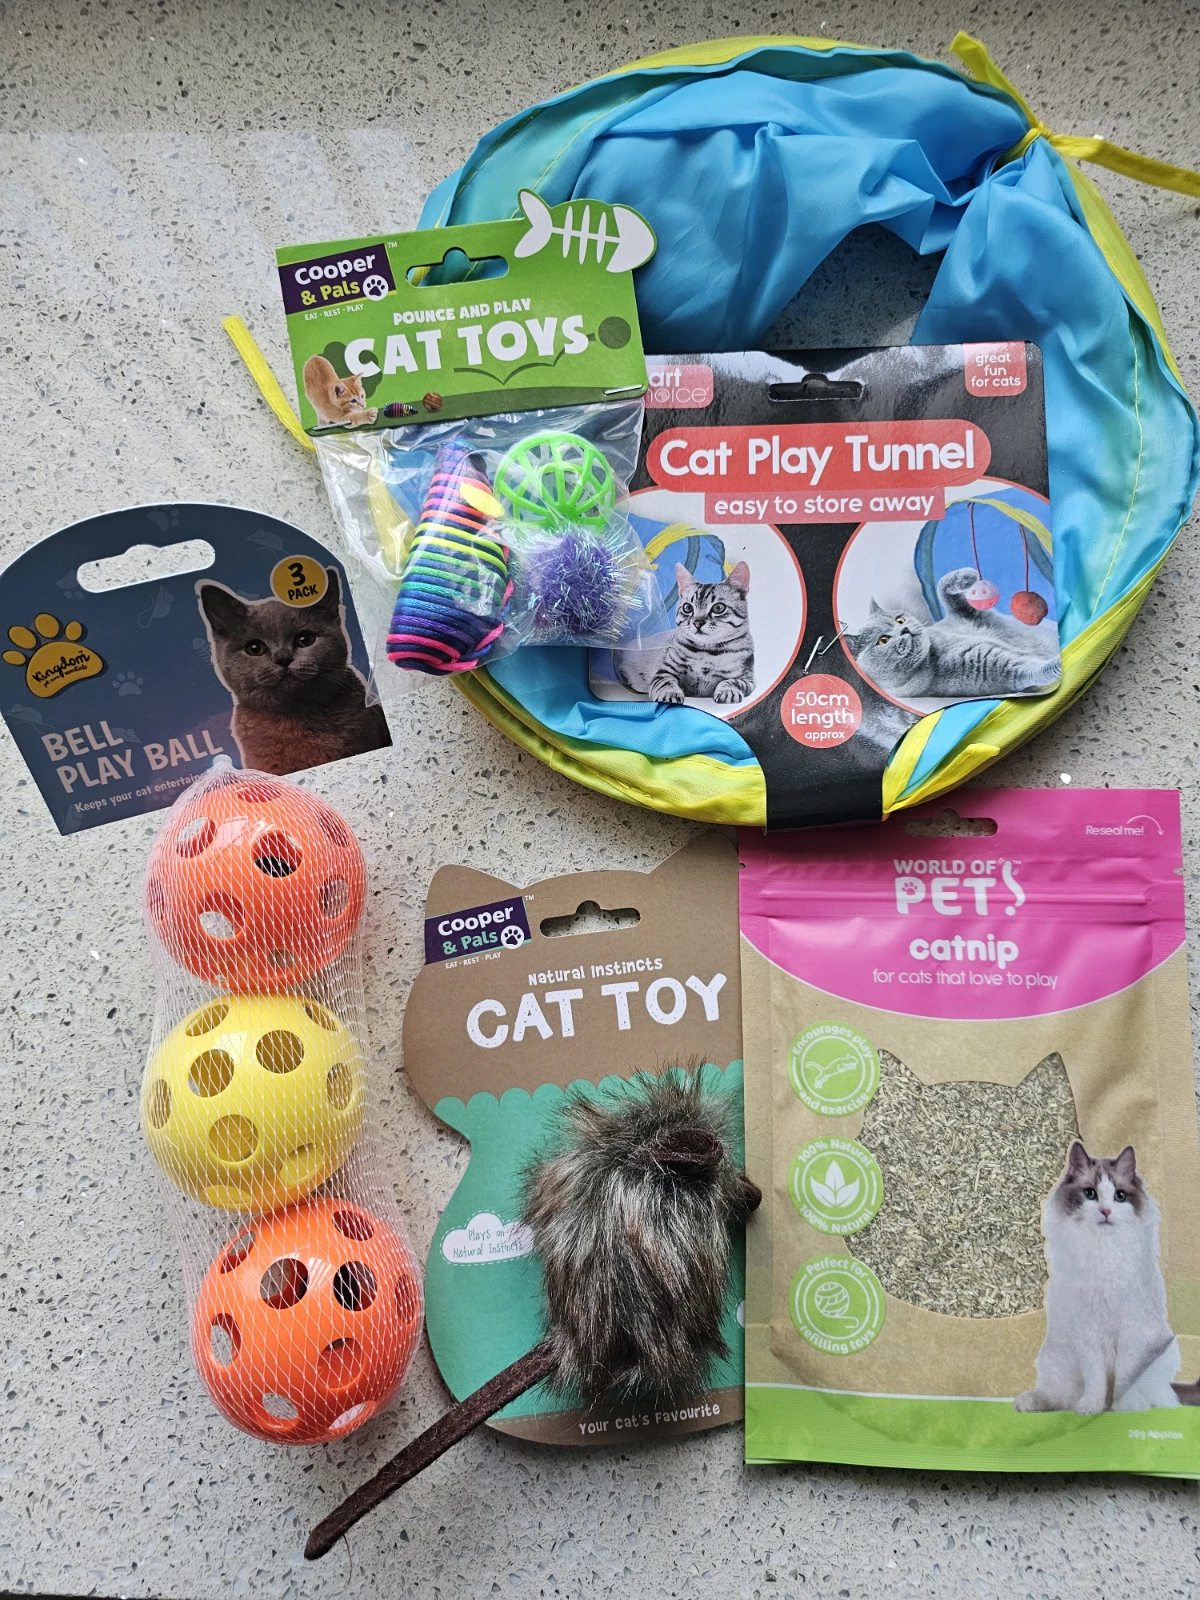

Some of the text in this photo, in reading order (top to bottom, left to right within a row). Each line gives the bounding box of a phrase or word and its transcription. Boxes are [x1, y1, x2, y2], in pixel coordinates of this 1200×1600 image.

[294, 254, 376, 285] Cooper
[300, 280, 361, 306] & Pals
[304, 303, 364, 321] EAT REST PLAY
[393, 298, 531, 326] POUNCE AND PLAY
[343, 315, 590, 378] CAT TOYS
[975, 352, 1011, 366] great
[971, 375, 1021, 388] for cats
[984, 365, 1007, 376] fun
[659, 429, 975, 486] Cat Play Tunnel
[714, 493, 936, 520] easy to store away
[287, 562, 306, 587] 3
[287, 584, 319, 601] PACK
[32, 653, 91, 683] Kingdom
[795, 691, 849, 707] 50cm
[791, 707, 855, 729] length
[41, 720, 124, 762] BELL
[804, 731, 845, 742] approx
[56, 729, 225, 794] PLAY BALL
[74, 797, 107, 813] Keeps
[110, 790, 132, 807] your
[135, 786, 152, 798] cat
[1085, 825, 1145, 836] Reseal me!
[893, 859, 997, 875] WORLD OF
[437, 906, 514, 936] Cooper
[442, 930, 498, 955] & Pals
[909, 933, 1019, 970] catnip
[445, 951, 502, 969] EAT REST PLAY
[528, 957, 664, 987] Natural Instincts
[872, 968, 1059, 990] for cats that love to play
[466, 972, 728, 1049] CAT TOY
[792, 1025, 873, 1058] Encourages play
[799, 1090, 869, 1114] and exercise
[798, 1139, 873, 1167] 100% Natural
[800, 1204, 874, 1233] 100% Natural
[468, 1229, 491, 1242] Plays
[453, 1243, 484, 1258] Natural
[805, 1257, 868, 1279] Perfect for
[800, 1325, 875, 1354] refilling toys
[578, 1403, 721, 1435] Your Cat's Favourite
